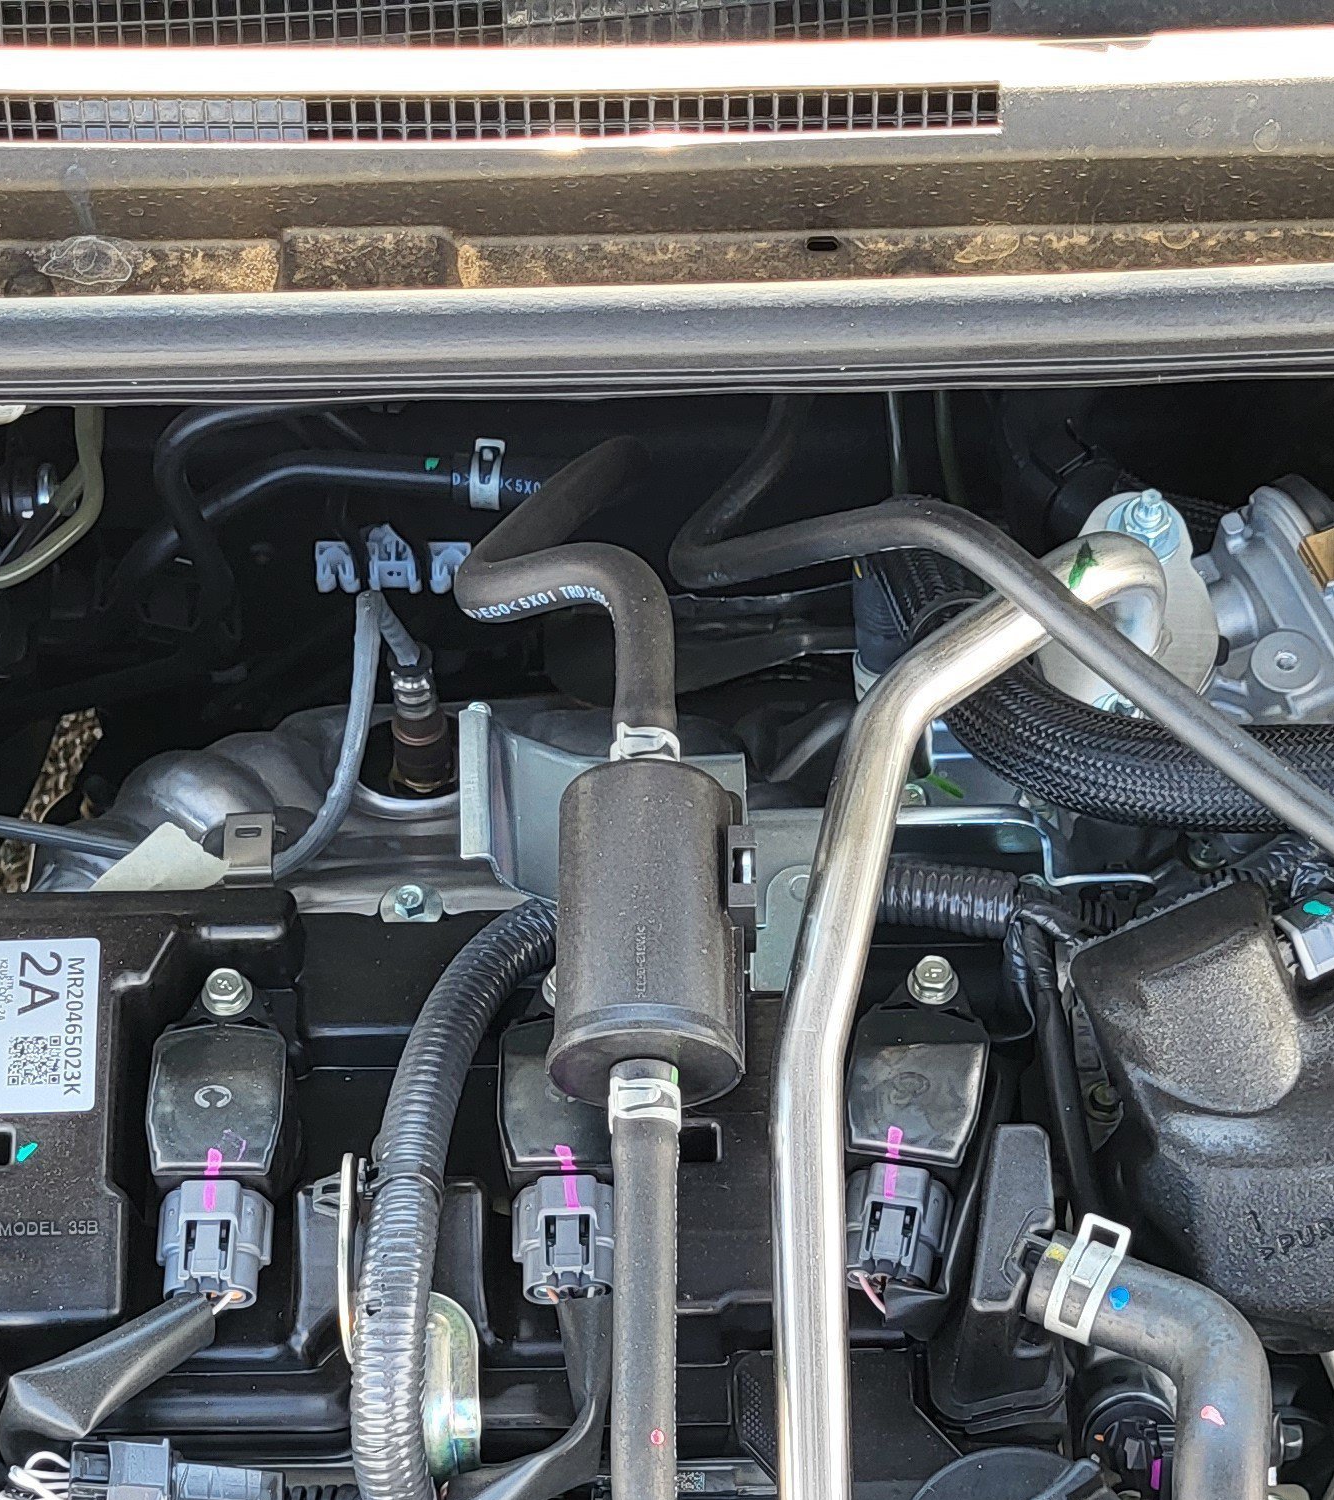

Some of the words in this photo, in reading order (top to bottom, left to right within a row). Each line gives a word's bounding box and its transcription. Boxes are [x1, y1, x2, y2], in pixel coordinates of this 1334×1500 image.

[17, 951, 62, 1016] 2A
[63, 957, 85, 1095] MR20465023K
[68, 1220, 98, 1235] 35B
